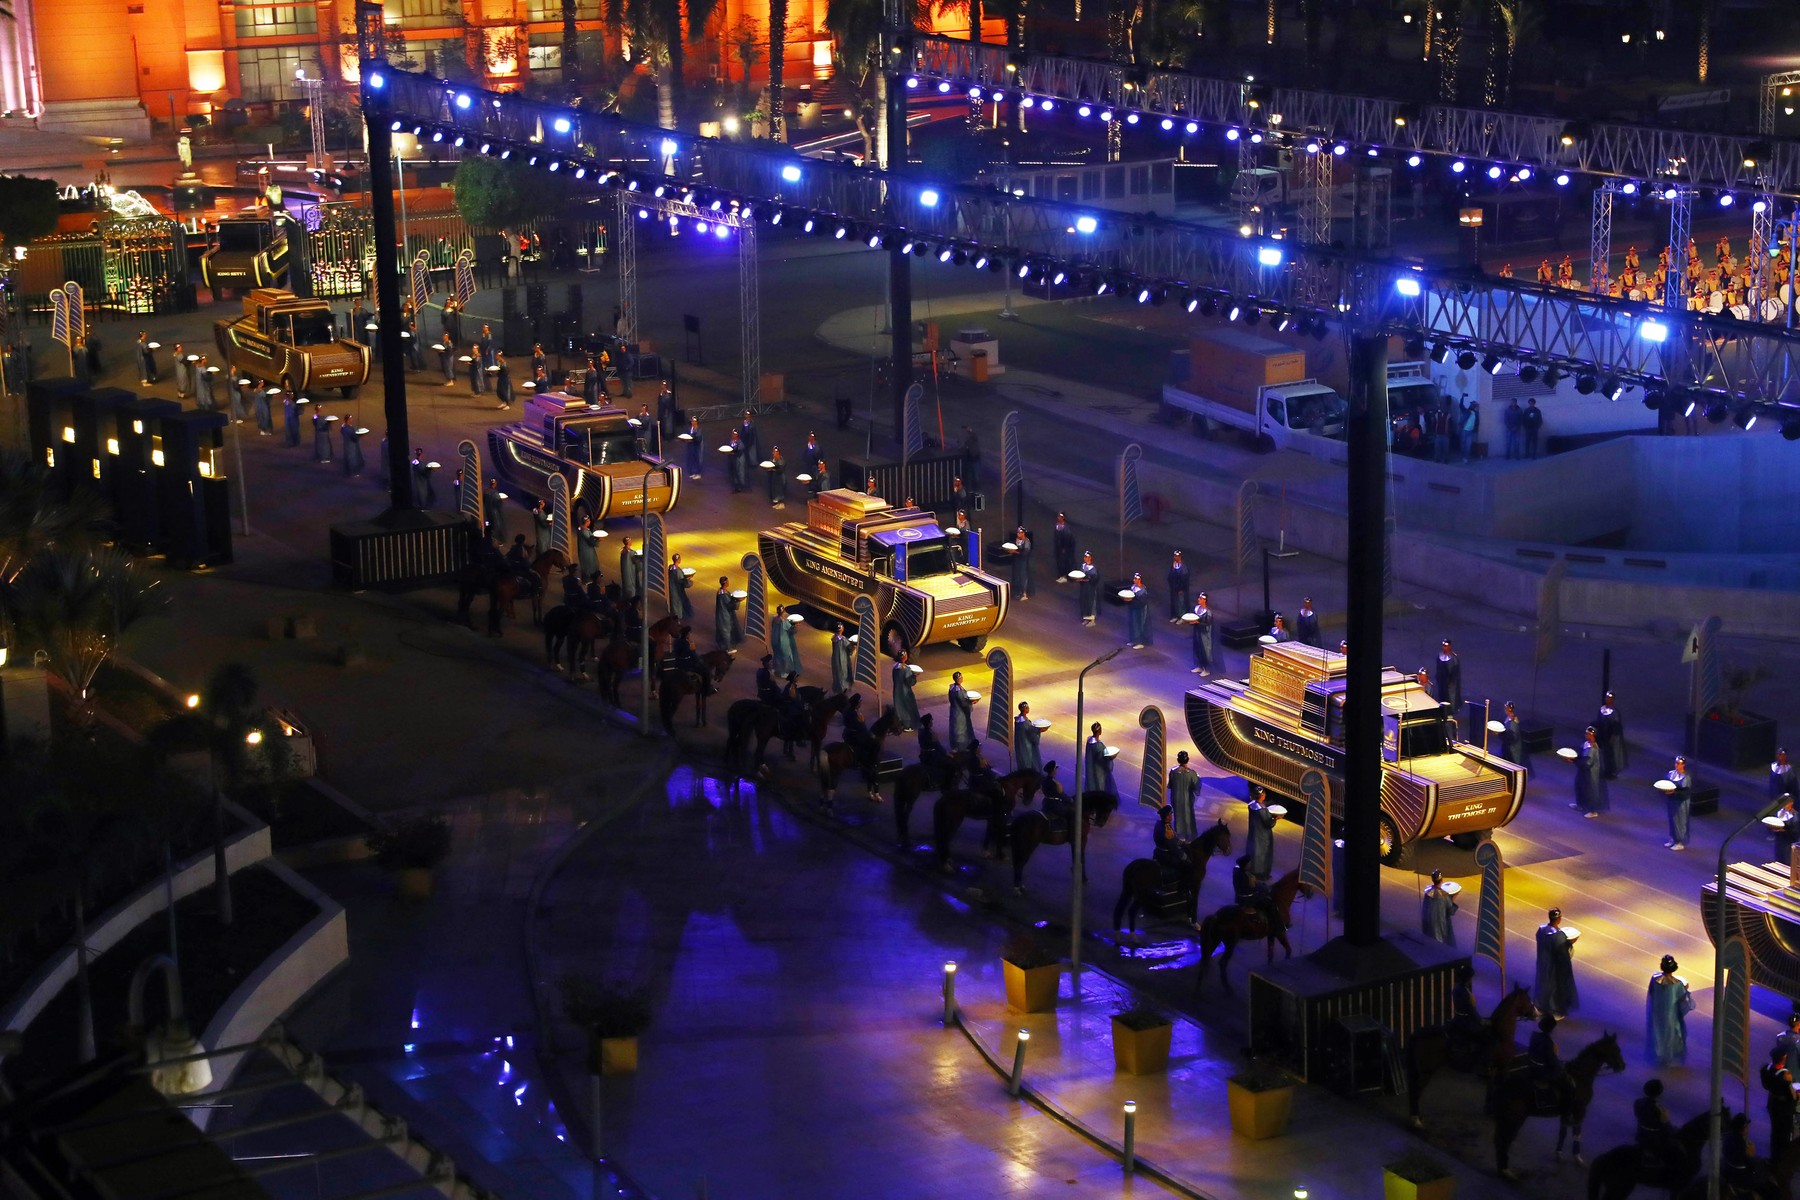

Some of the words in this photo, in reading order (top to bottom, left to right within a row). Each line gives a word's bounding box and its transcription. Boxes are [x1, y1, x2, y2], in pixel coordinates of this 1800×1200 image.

[806, 559, 820, 571] KING
[821, 564, 858, 587] AMENHOTEP
[858, 580, 864, 590] II
[943, 618, 980, 629] AMENHOTEP
[1253, 726, 1276, 744] KING
[1276, 736, 1325, 765] THUTMOSE
[1325, 755, 1335, 768] III
[1464, 802, 1484, 811] KING
[1448, 808, 1487, 820] THUTMOSE
